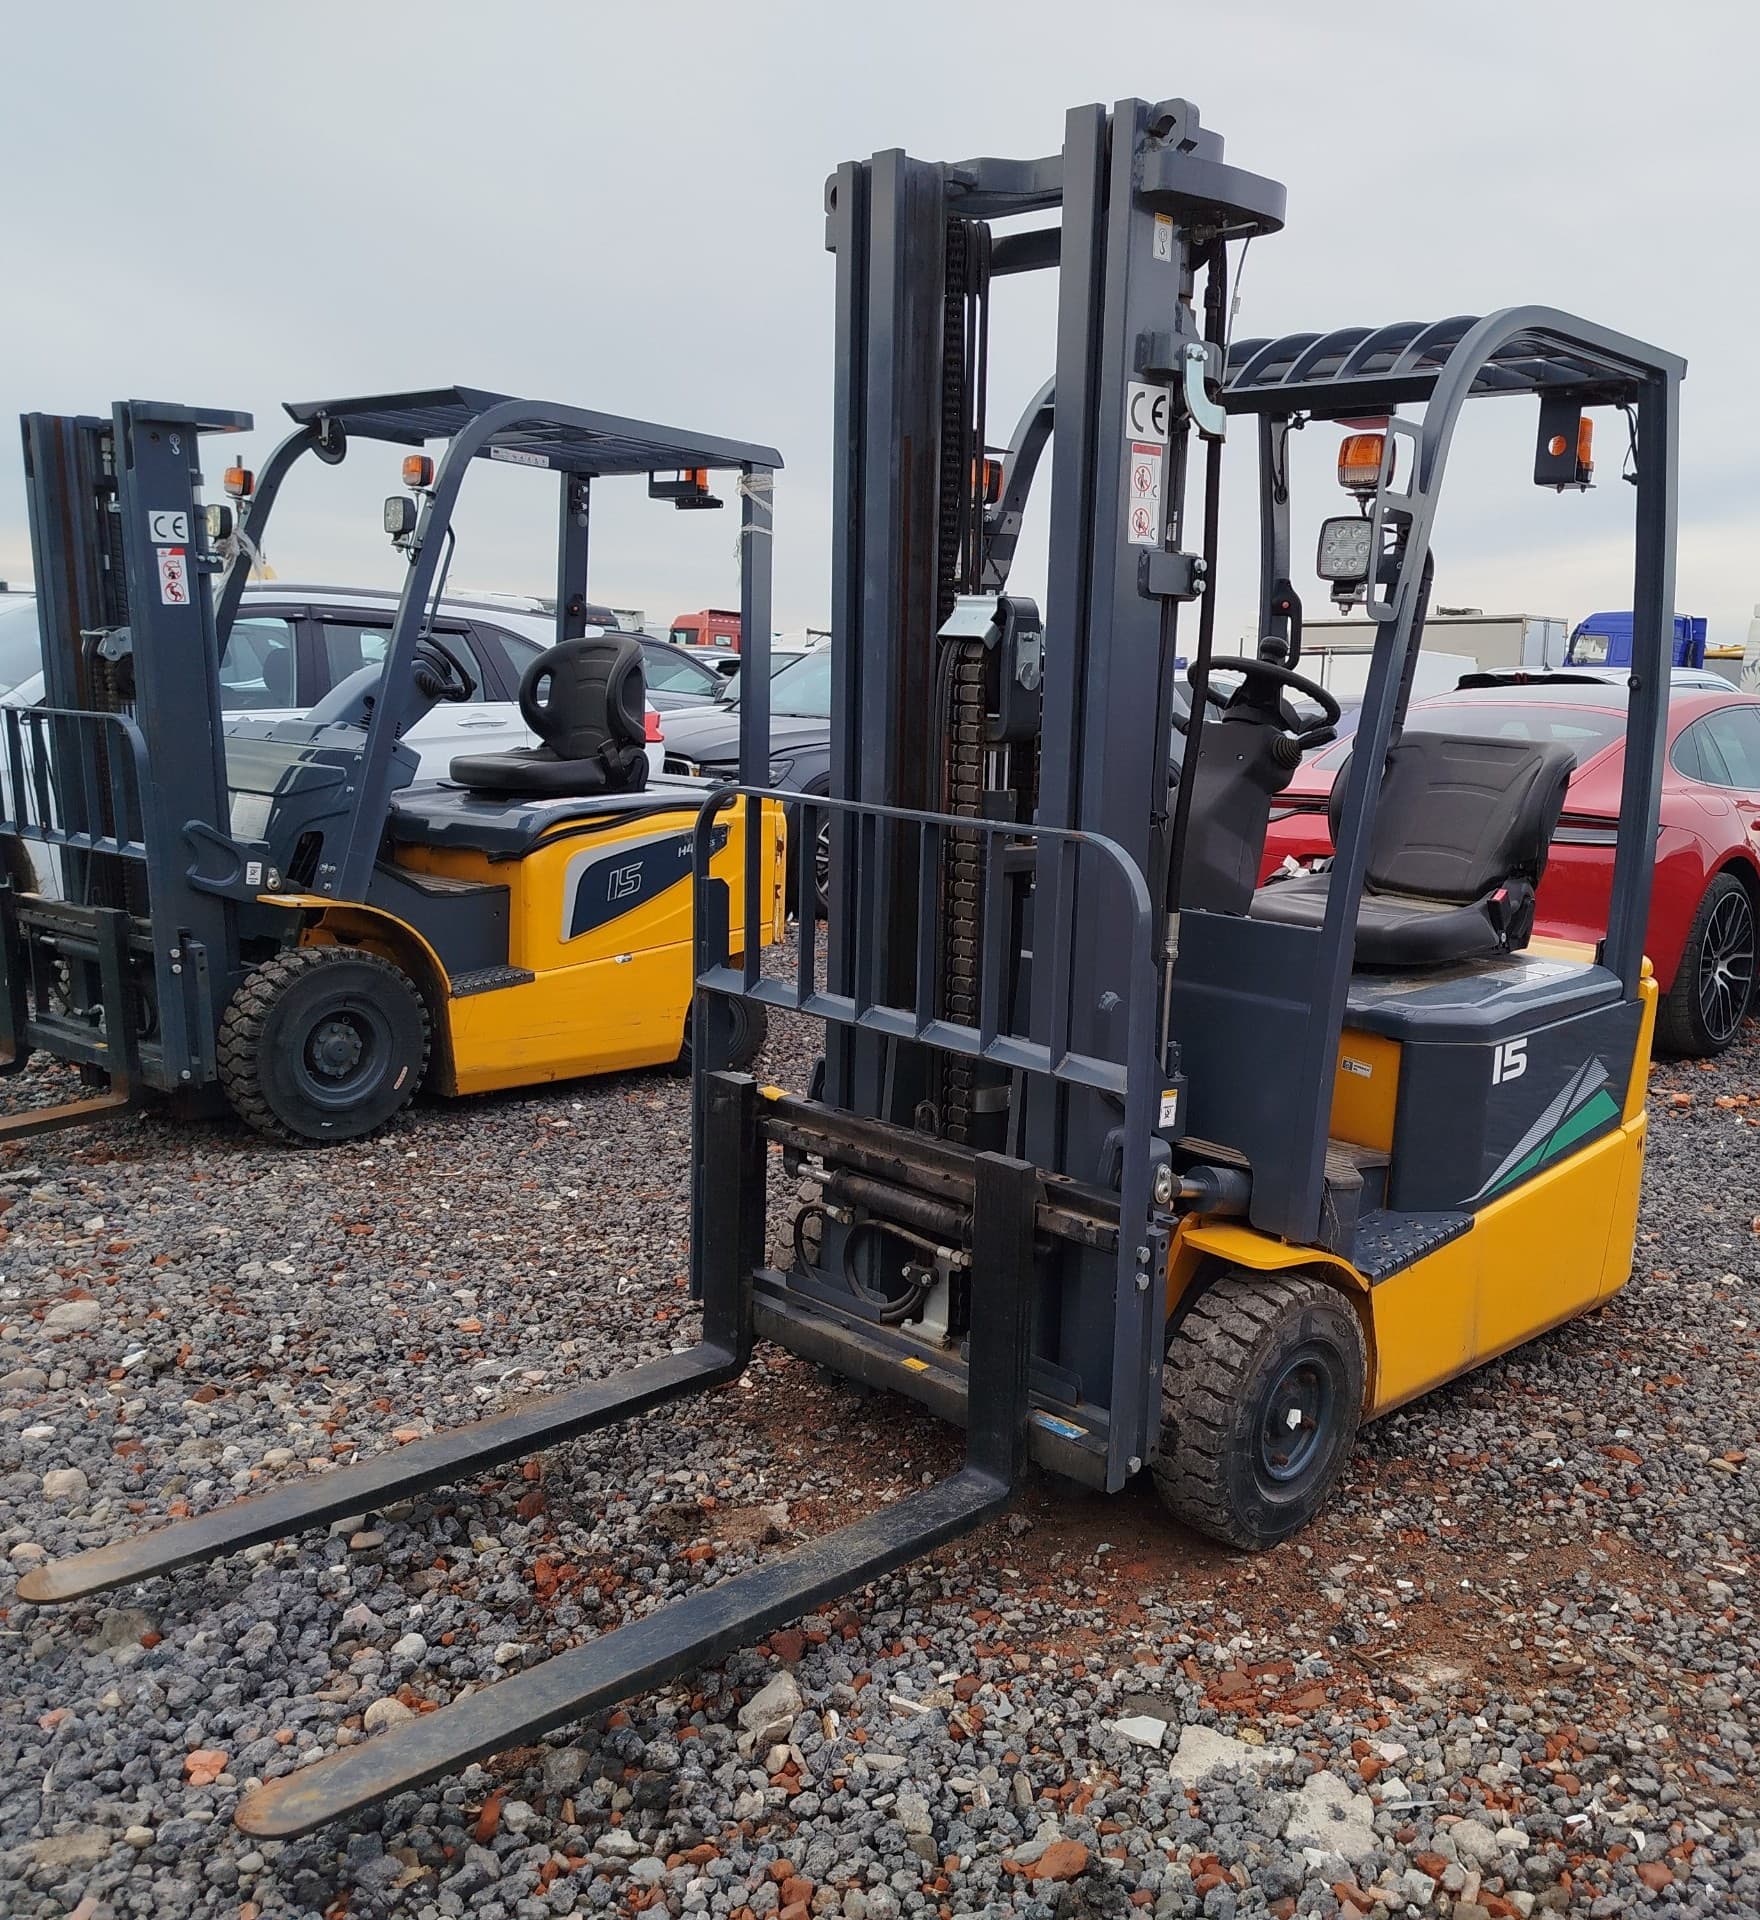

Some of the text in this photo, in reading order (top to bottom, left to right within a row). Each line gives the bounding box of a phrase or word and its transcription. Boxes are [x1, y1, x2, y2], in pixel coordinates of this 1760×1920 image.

[1131, 391, 1166, 436] CE
[154, 515, 185, 539] CE
[607, 861, 644, 901] 15
[1492, 1038, 1527, 1085] 15
